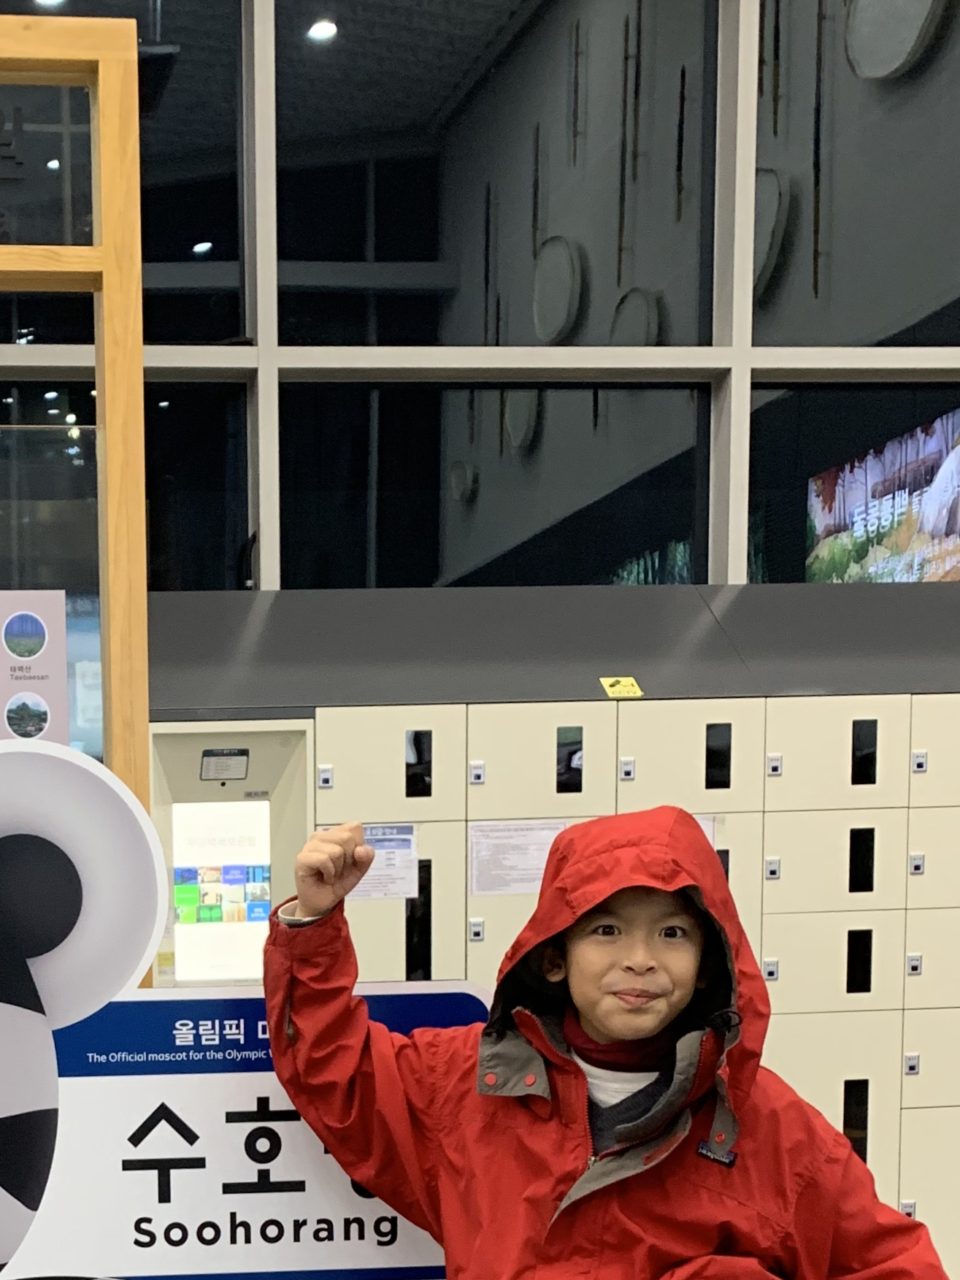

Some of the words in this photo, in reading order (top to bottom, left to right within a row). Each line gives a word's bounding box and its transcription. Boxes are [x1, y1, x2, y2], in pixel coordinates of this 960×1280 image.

[172, 1018, 246, 1046] 올림픽
[86, 1052, 108, 1063] The
[108, 1051, 147, 1063] Official
[147, 1050, 188, 1062] mascot
[189, 1049, 204, 1061] for
[205, 1049, 224, 1060] the
[225, 1048, 268, 1061] Olympic
[121, 1096, 378, 1204] 수호
[133, 1211, 399, 1248] Soohorang
